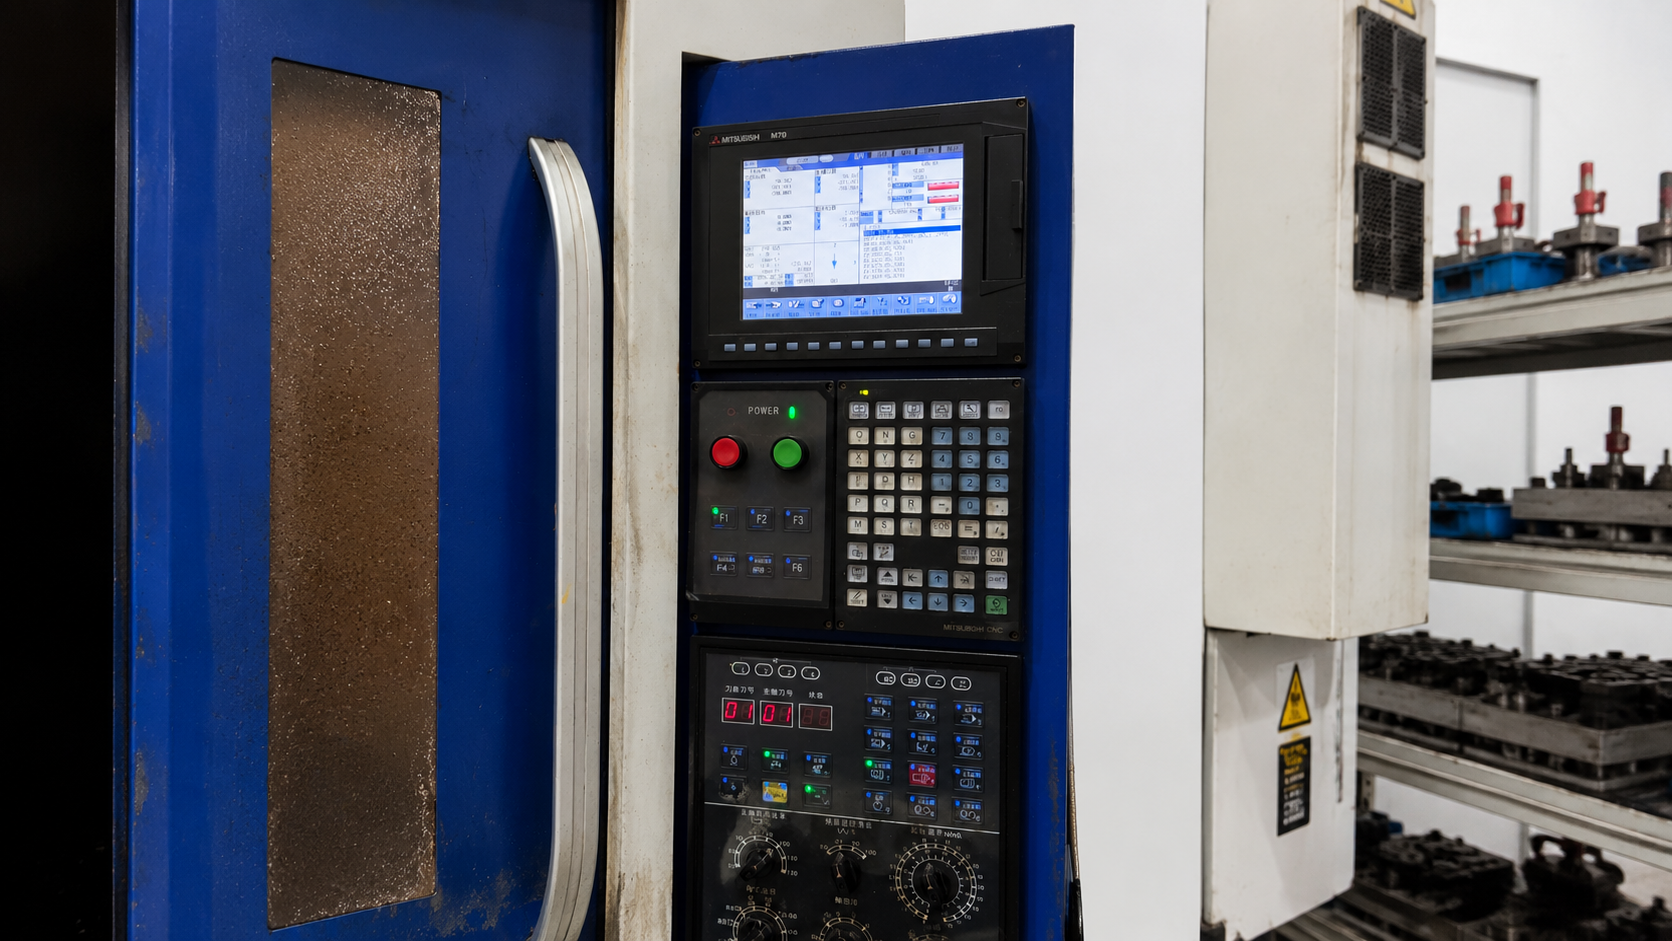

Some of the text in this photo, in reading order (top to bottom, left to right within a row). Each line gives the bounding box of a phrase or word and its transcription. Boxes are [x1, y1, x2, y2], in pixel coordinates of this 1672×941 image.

[748, 406, 779, 415] POWER
[909, 431, 916, 439] G
[967, 455, 973, 463] 5
[967, 479, 972, 487] 2
[995, 479, 1000, 488] 3
[720, 514, 728, 523] F1
[756, 514, 767, 524] F2
[793, 516, 803, 525] F3
[792, 563, 802, 572] F6
[725, 701, 753, 719] 01
[763, 704, 792, 722] 01
